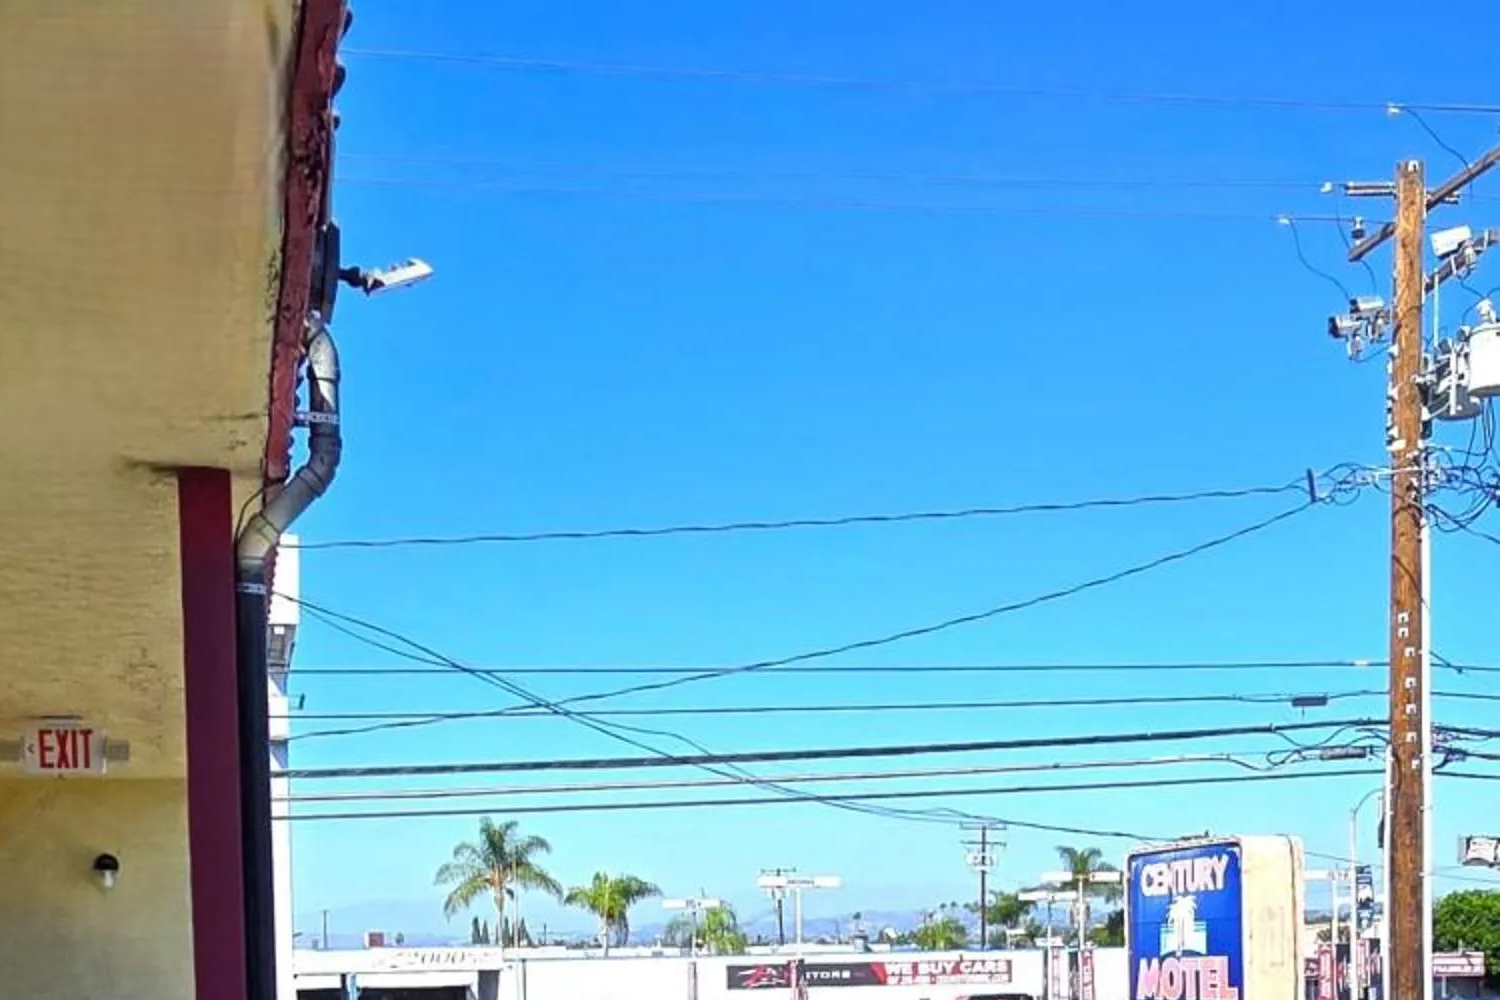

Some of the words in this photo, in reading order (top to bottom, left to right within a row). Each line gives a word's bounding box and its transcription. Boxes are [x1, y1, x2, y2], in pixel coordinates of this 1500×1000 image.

[38, 728, 94, 769] EXIT
[1141, 854, 1229, 897] CENTURY
[918, 961, 955, 975] BUY
[960, 960, 1007, 973] CARS
